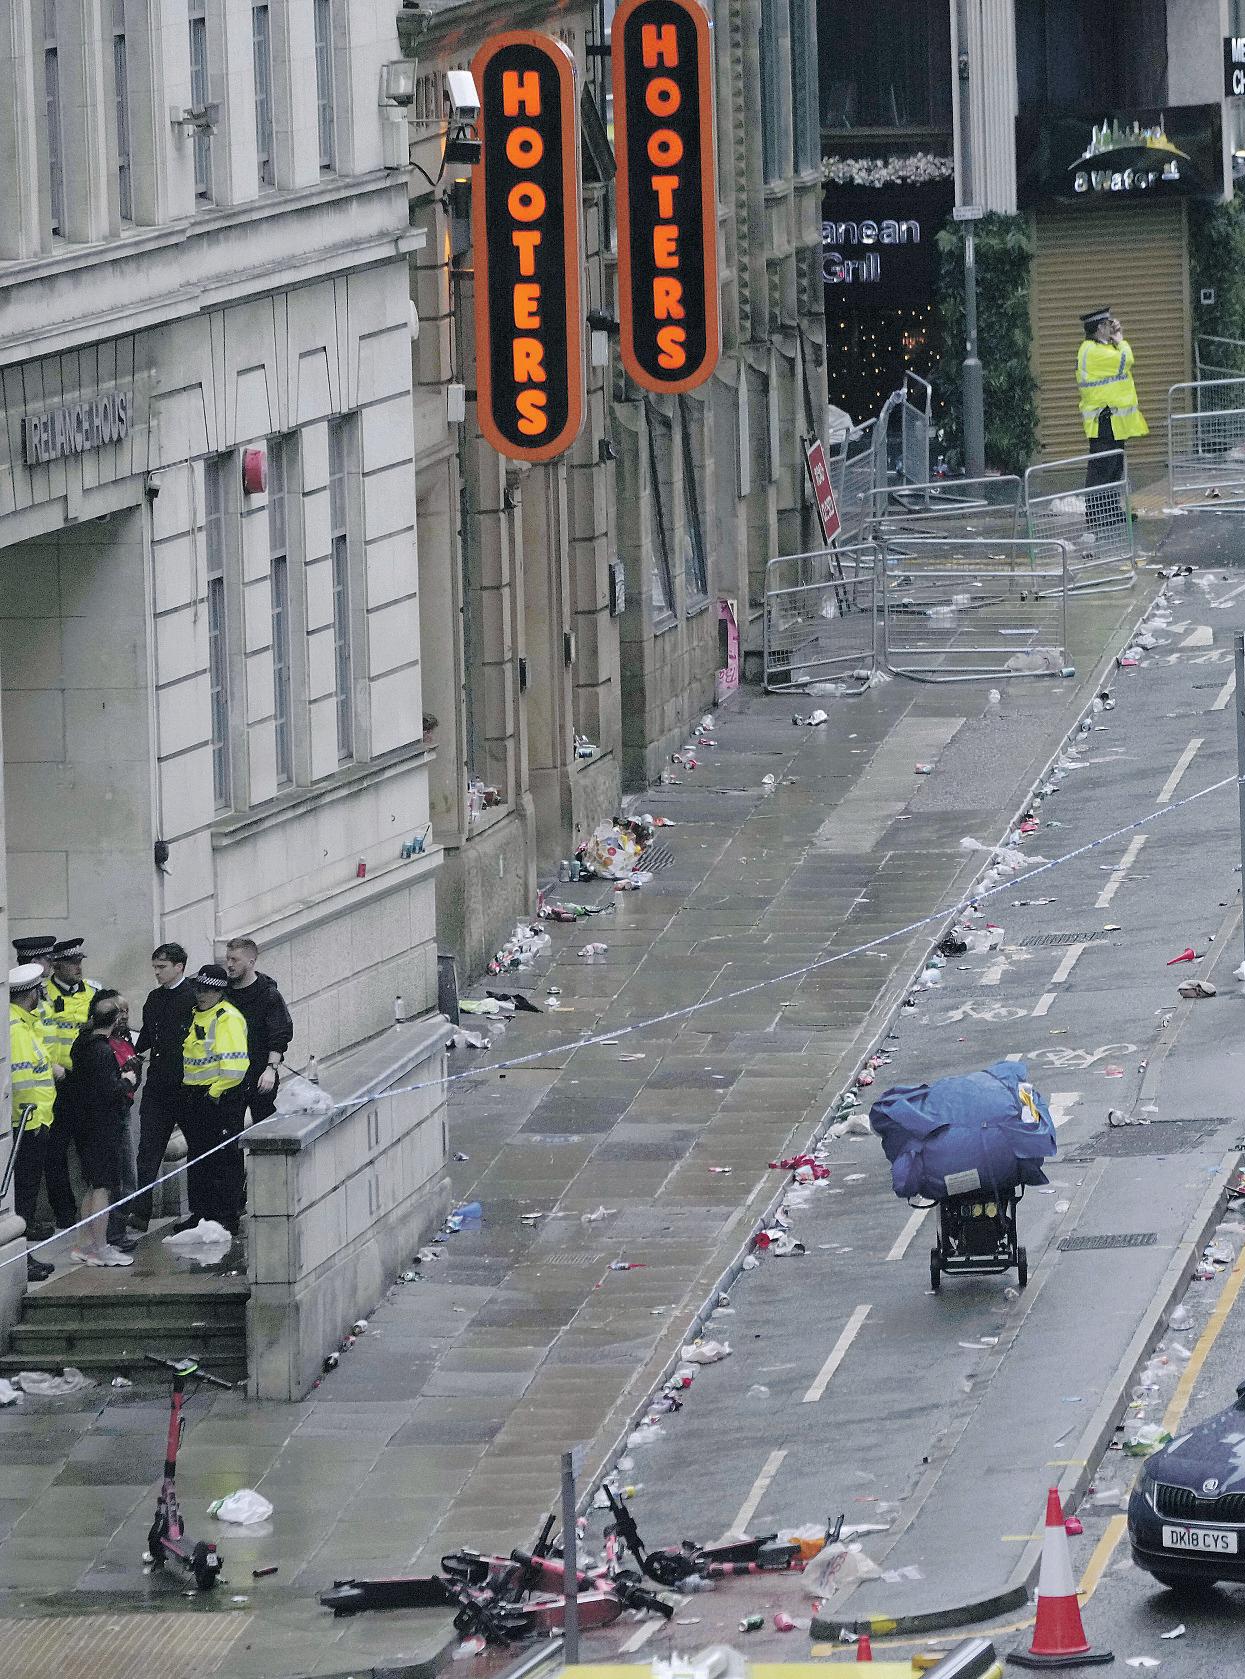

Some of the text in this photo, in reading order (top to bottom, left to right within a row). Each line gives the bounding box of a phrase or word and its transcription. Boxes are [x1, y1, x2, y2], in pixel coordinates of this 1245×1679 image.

[642, 24, 686, 370] HOOTERS
[502, 70, 547, 436] HOOTERS
[822, 219, 920, 245] anean
[23, 401, 92, 464] RELIANCE
[1170, 1531, 1229, 1549] DK18 CYS
